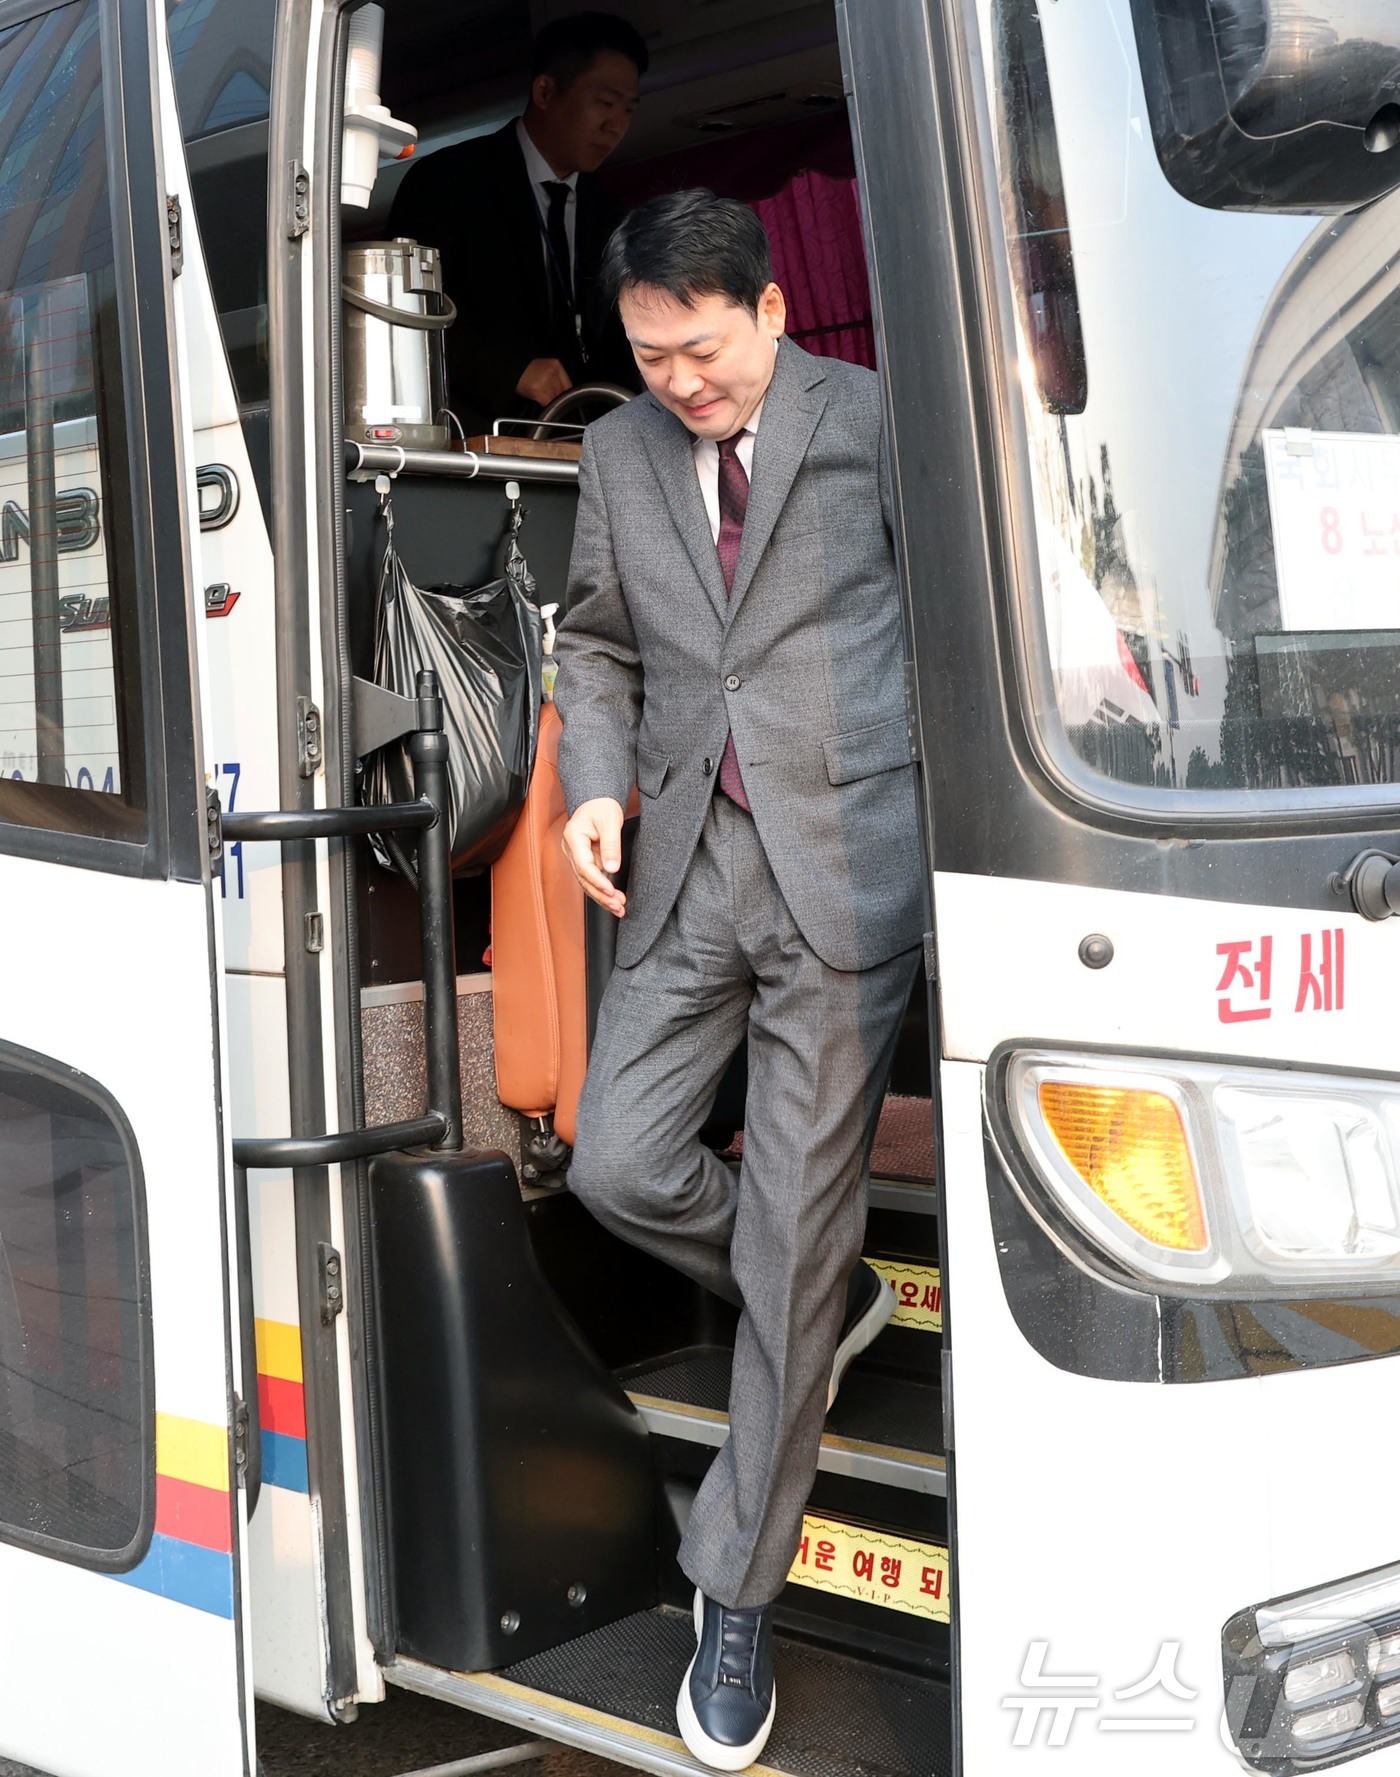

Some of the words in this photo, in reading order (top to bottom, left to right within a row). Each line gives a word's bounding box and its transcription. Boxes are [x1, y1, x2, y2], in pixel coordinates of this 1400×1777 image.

[1320, 506, 1344, 555] 8
[1216, 928, 1344, 1024] 전세
[888, 1279, 941, 1313] 오세
[852, 1550, 902, 1588] 여행
